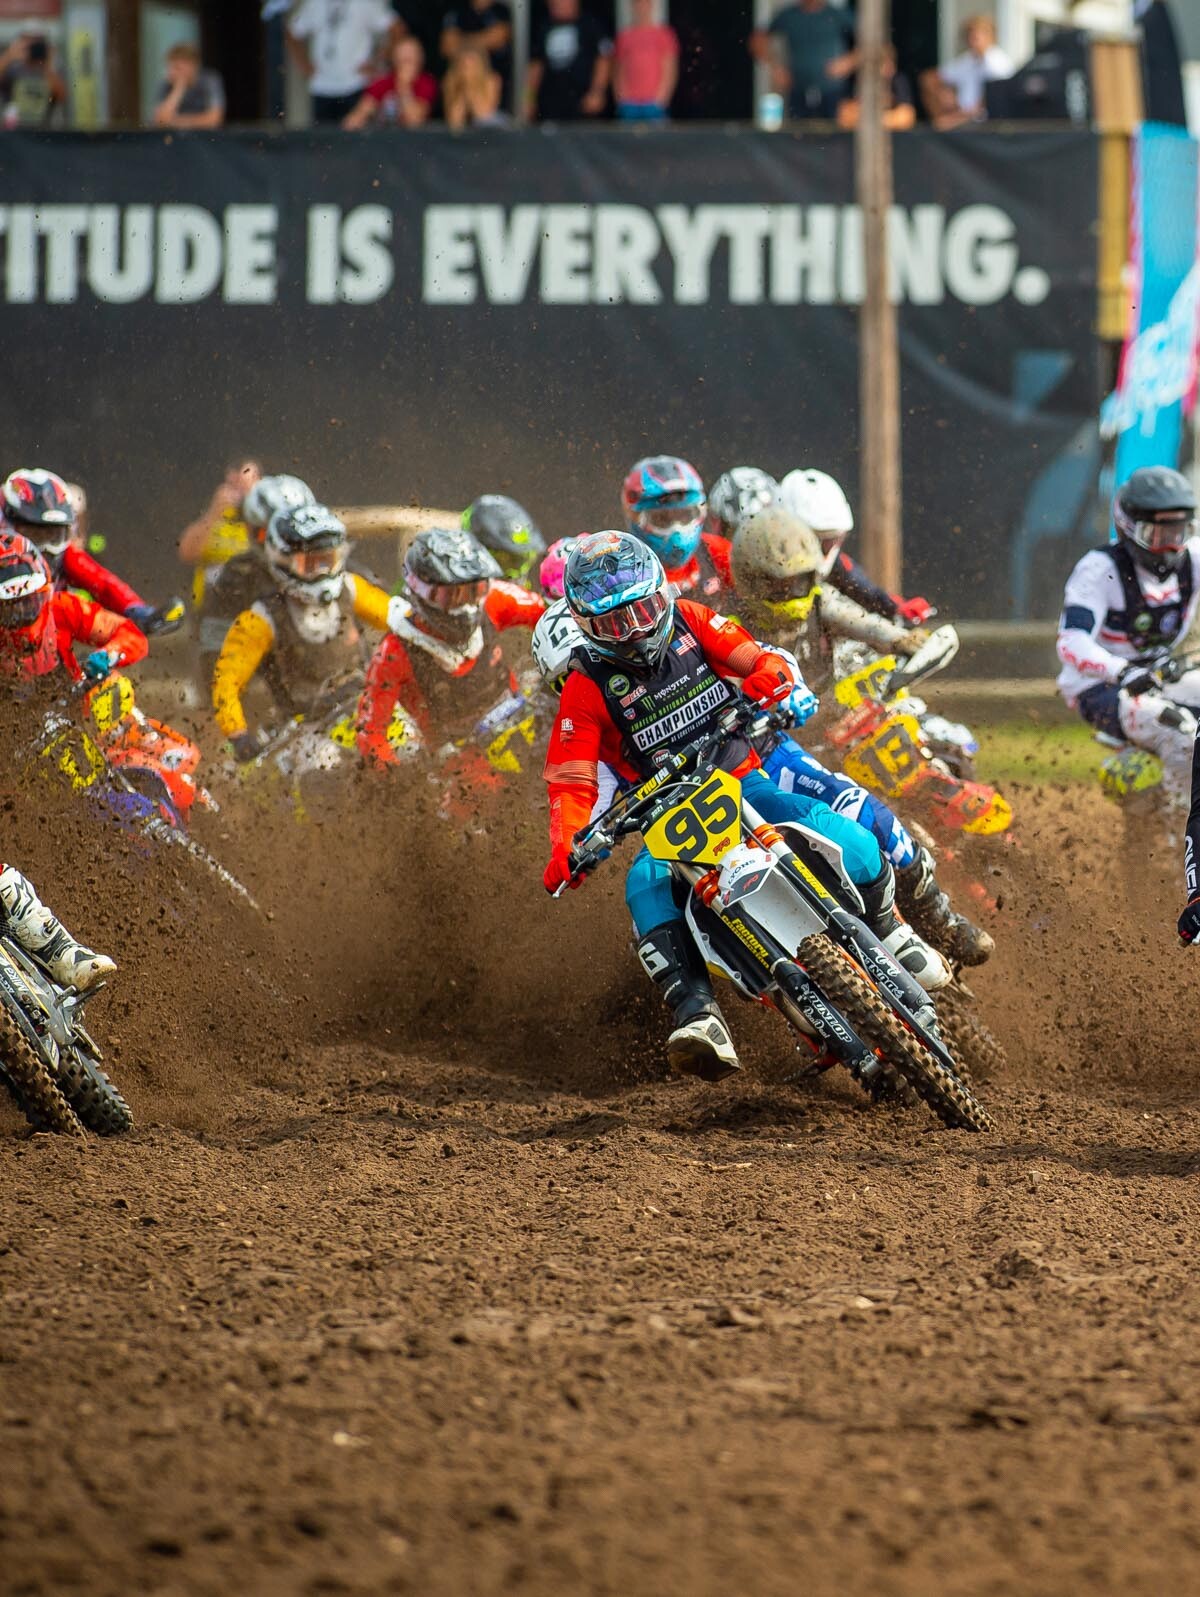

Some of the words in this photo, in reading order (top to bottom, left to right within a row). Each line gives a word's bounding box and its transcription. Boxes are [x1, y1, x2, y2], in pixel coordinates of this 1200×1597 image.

[0, 203, 278, 304] ITUDE
[306, 203, 394, 304] IS
[422, 203, 1050, 306] EVERYTHING.
[636, 683, 727, 749] CHAMPIONSHIP
[653, 674, 692, 701] MONSTER
[664, 778, 739, 862] 95
[732, 917, 769, 959] Factory
[809, 992, 853, 1043] DUNLOP
